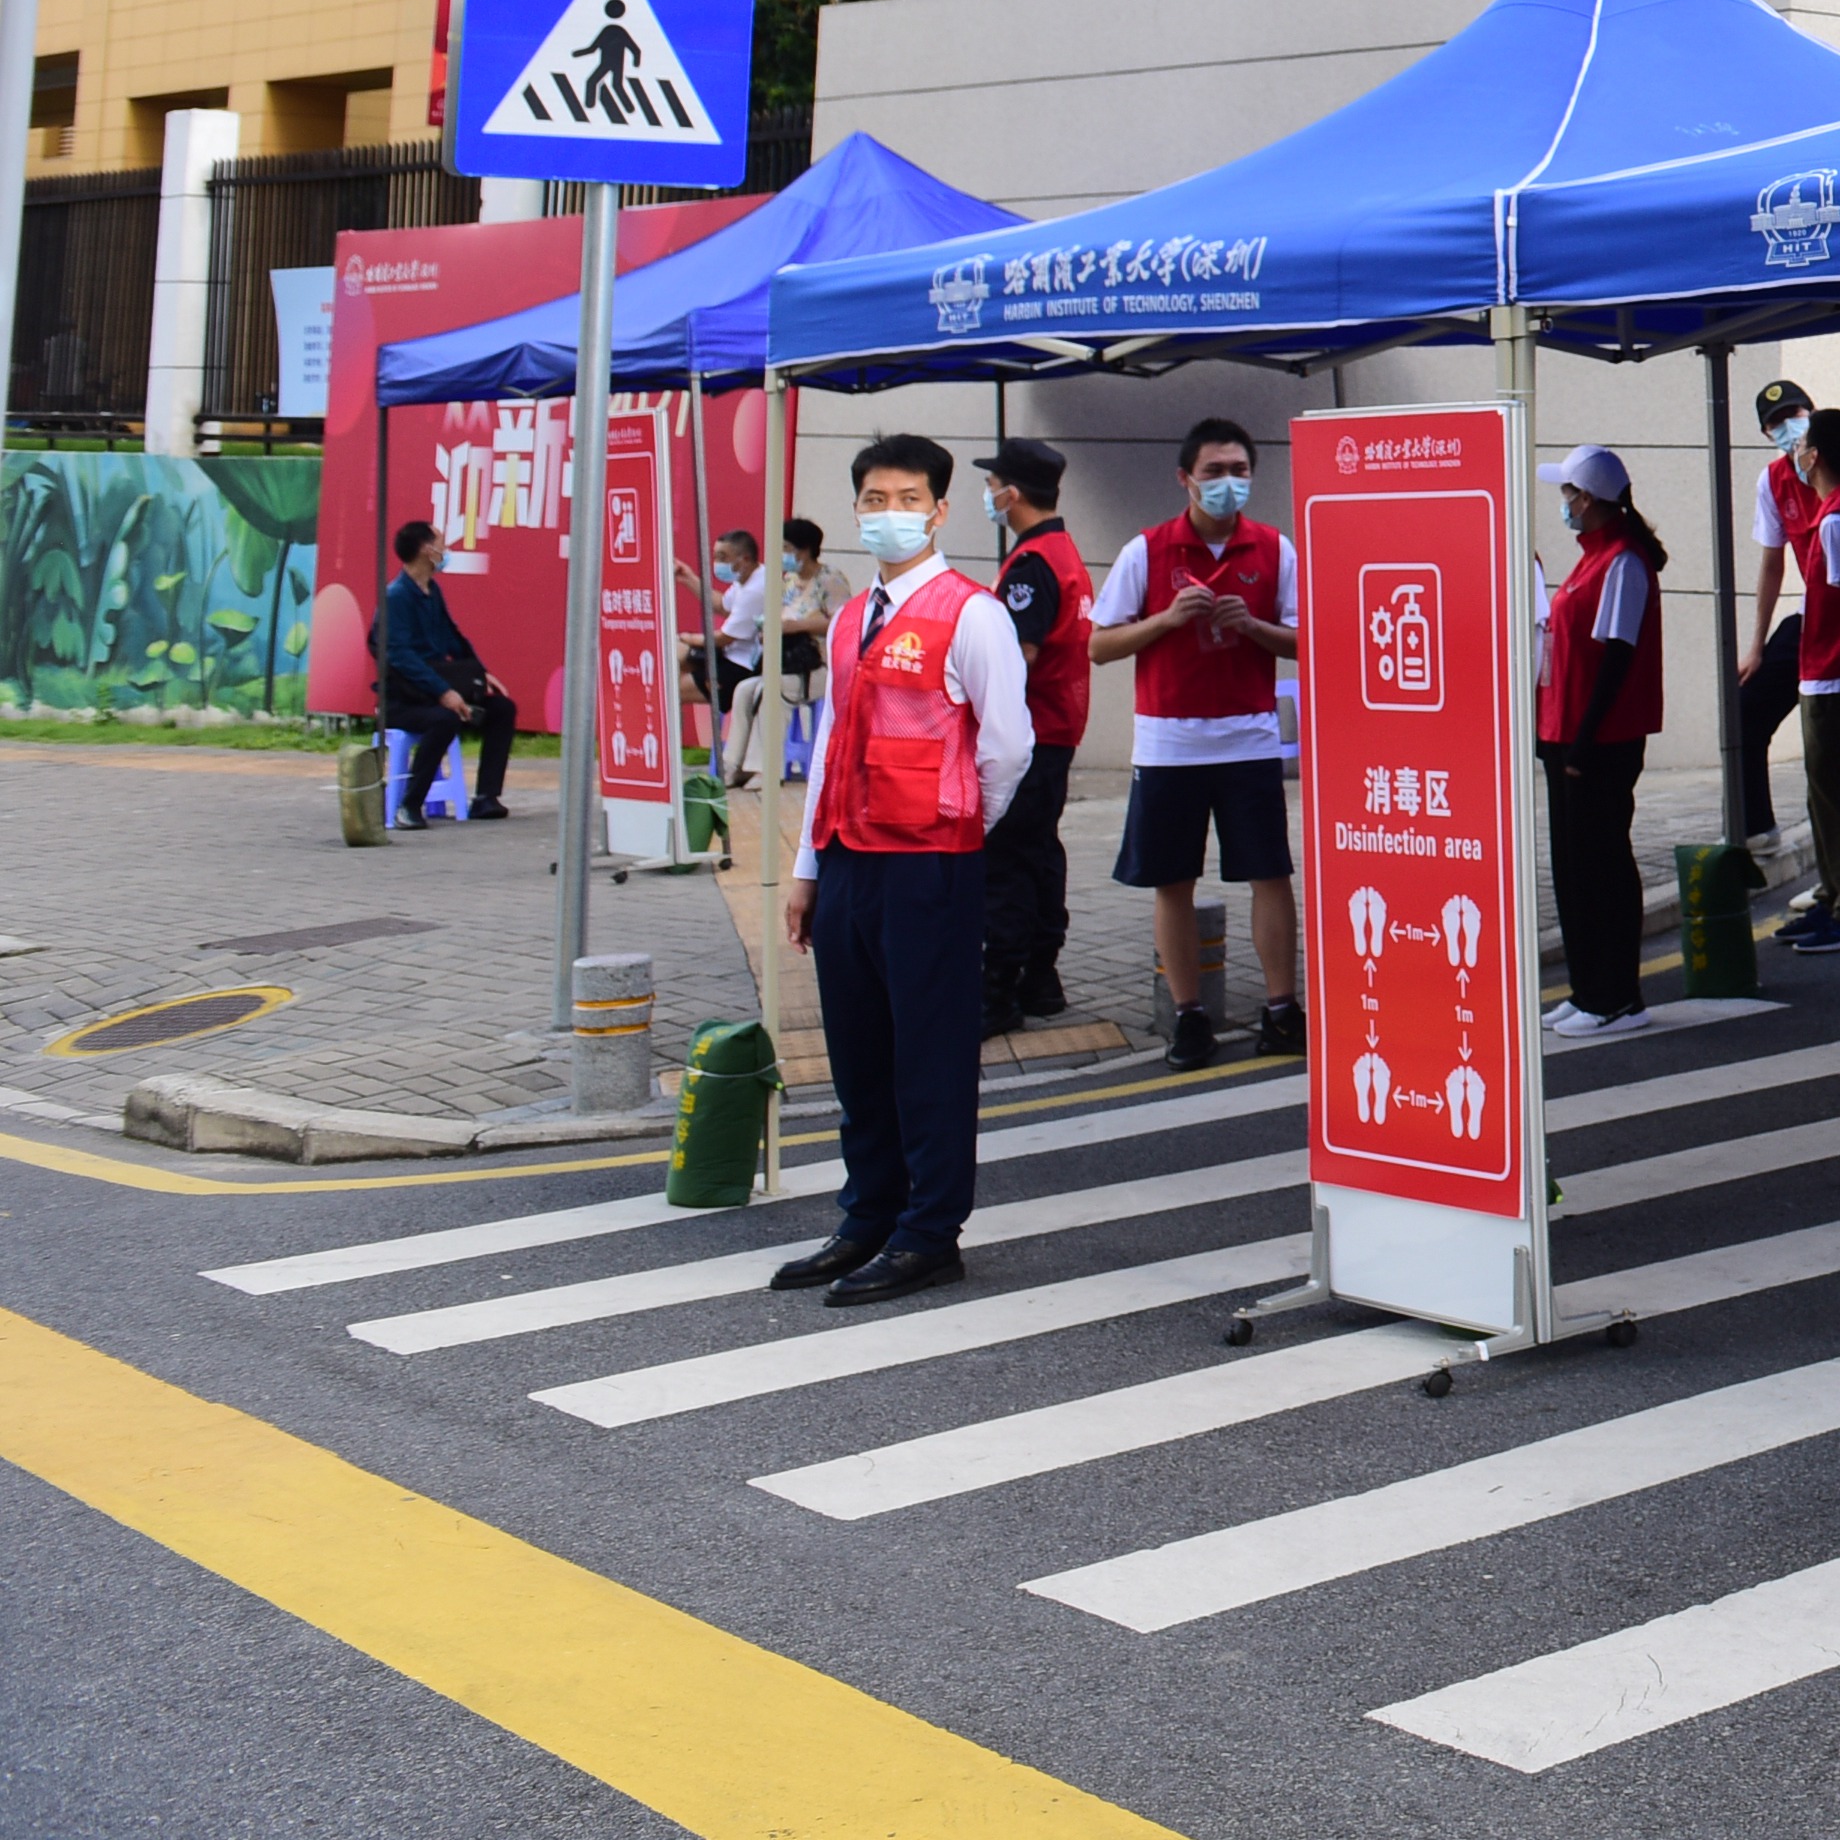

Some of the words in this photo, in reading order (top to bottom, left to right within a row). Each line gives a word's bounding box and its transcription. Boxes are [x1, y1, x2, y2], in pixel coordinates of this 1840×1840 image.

[1782, 241, 1811, 254] HIT
[1003, 302, 1042, 322] HARBIN
[1047, 297, 1098, 317] INSTITUTE
[1103, 296, 1117, 314] OF
[1123, 294, 1197, 314] TECHNOLOGY,
[1200, 292, 1260, 311] SHENZHEN
[1363, 765, 1451, 817] 消毒区
[1335, 822, 1437, 857] Disinfection
[1444, 837, 1482, 861] area
[1405, 923, 1424, 942] 1m
[1361, 994, 1379, 1012] 1m
[1454, 1004, 1474, 1024] 1m
[1408, 1089, 1428, 1108] 1m
